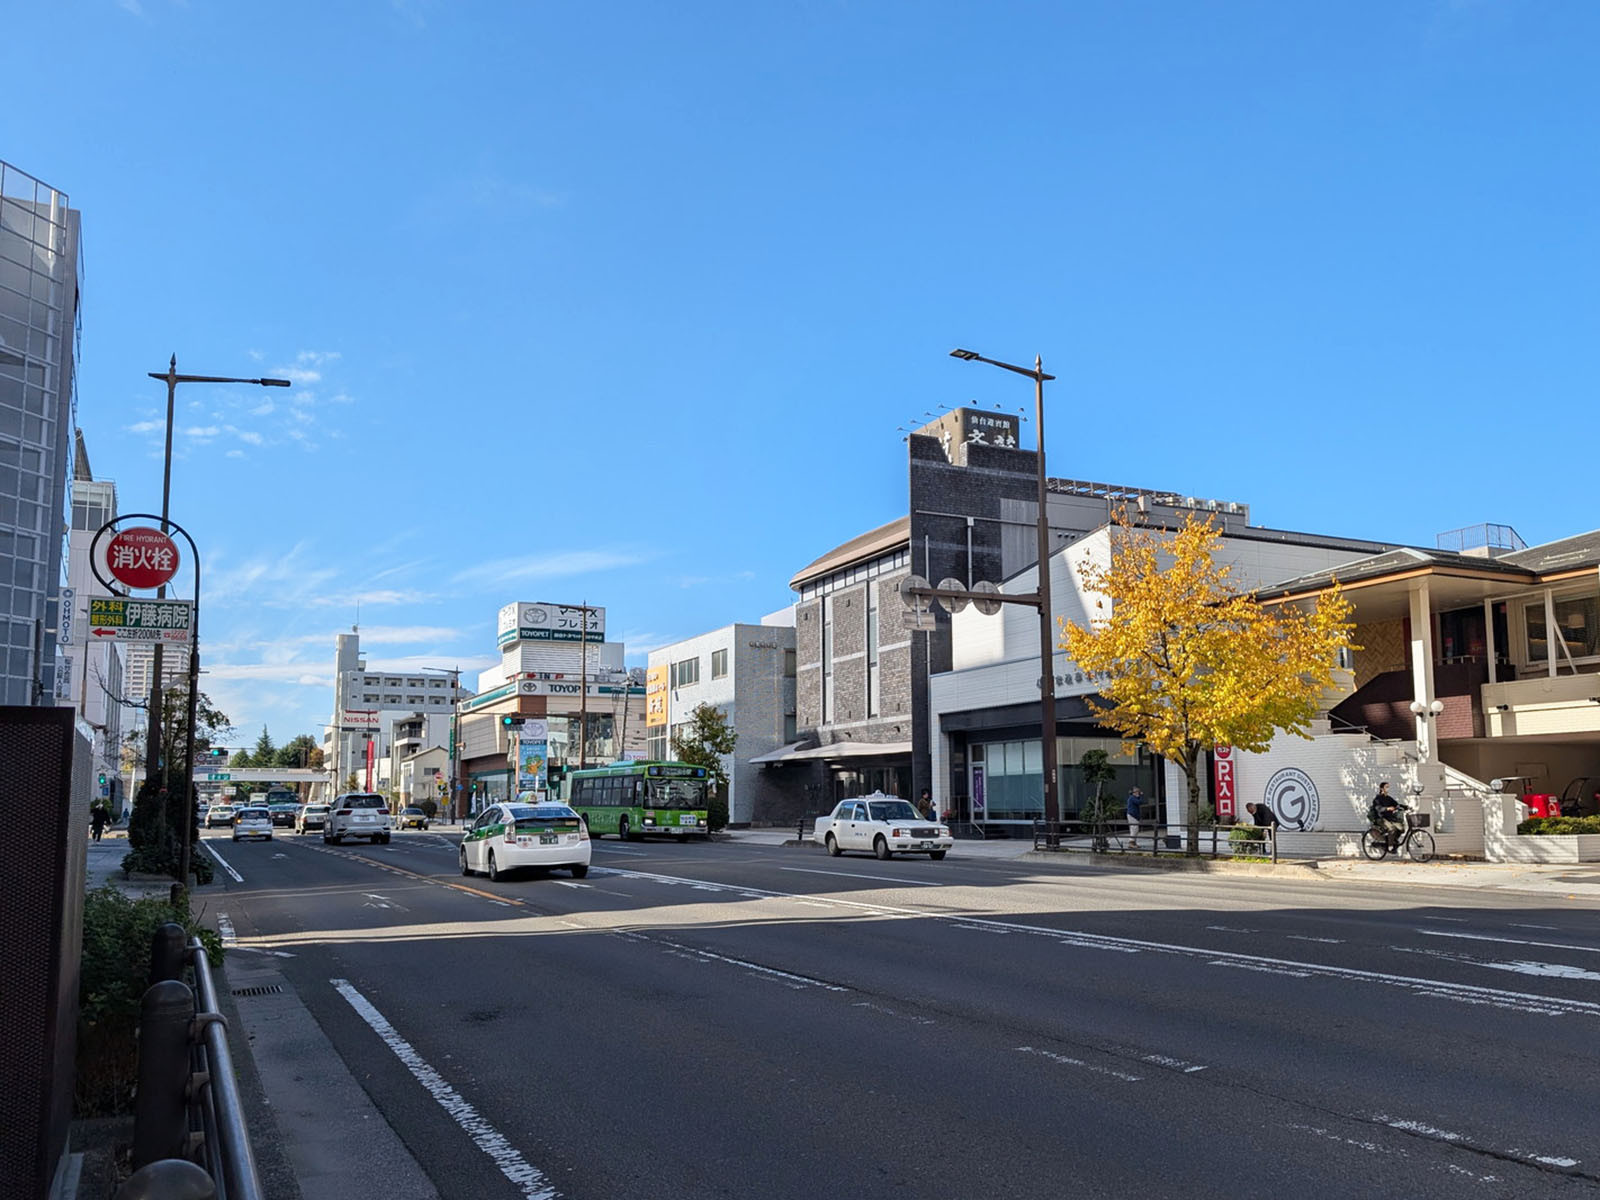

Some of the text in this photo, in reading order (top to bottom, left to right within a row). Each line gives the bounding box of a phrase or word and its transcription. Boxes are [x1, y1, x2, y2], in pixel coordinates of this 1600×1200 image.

[119, 534, 167, 544] FIRE HYDRANT
[113, 544, 174, 571] 消火栓
[92, 601, 124, 612] 外科
[126, 602, 188, 628] 伊藤病院
[62, 600, 72, 643] OHMOTO
[521, 630, 549, 638] TOYOPET
[548, 684, 593, 694] TOYOPT
[343, 716, 379, 724] NISSAN
[1277, 785, 1306, 823] G
